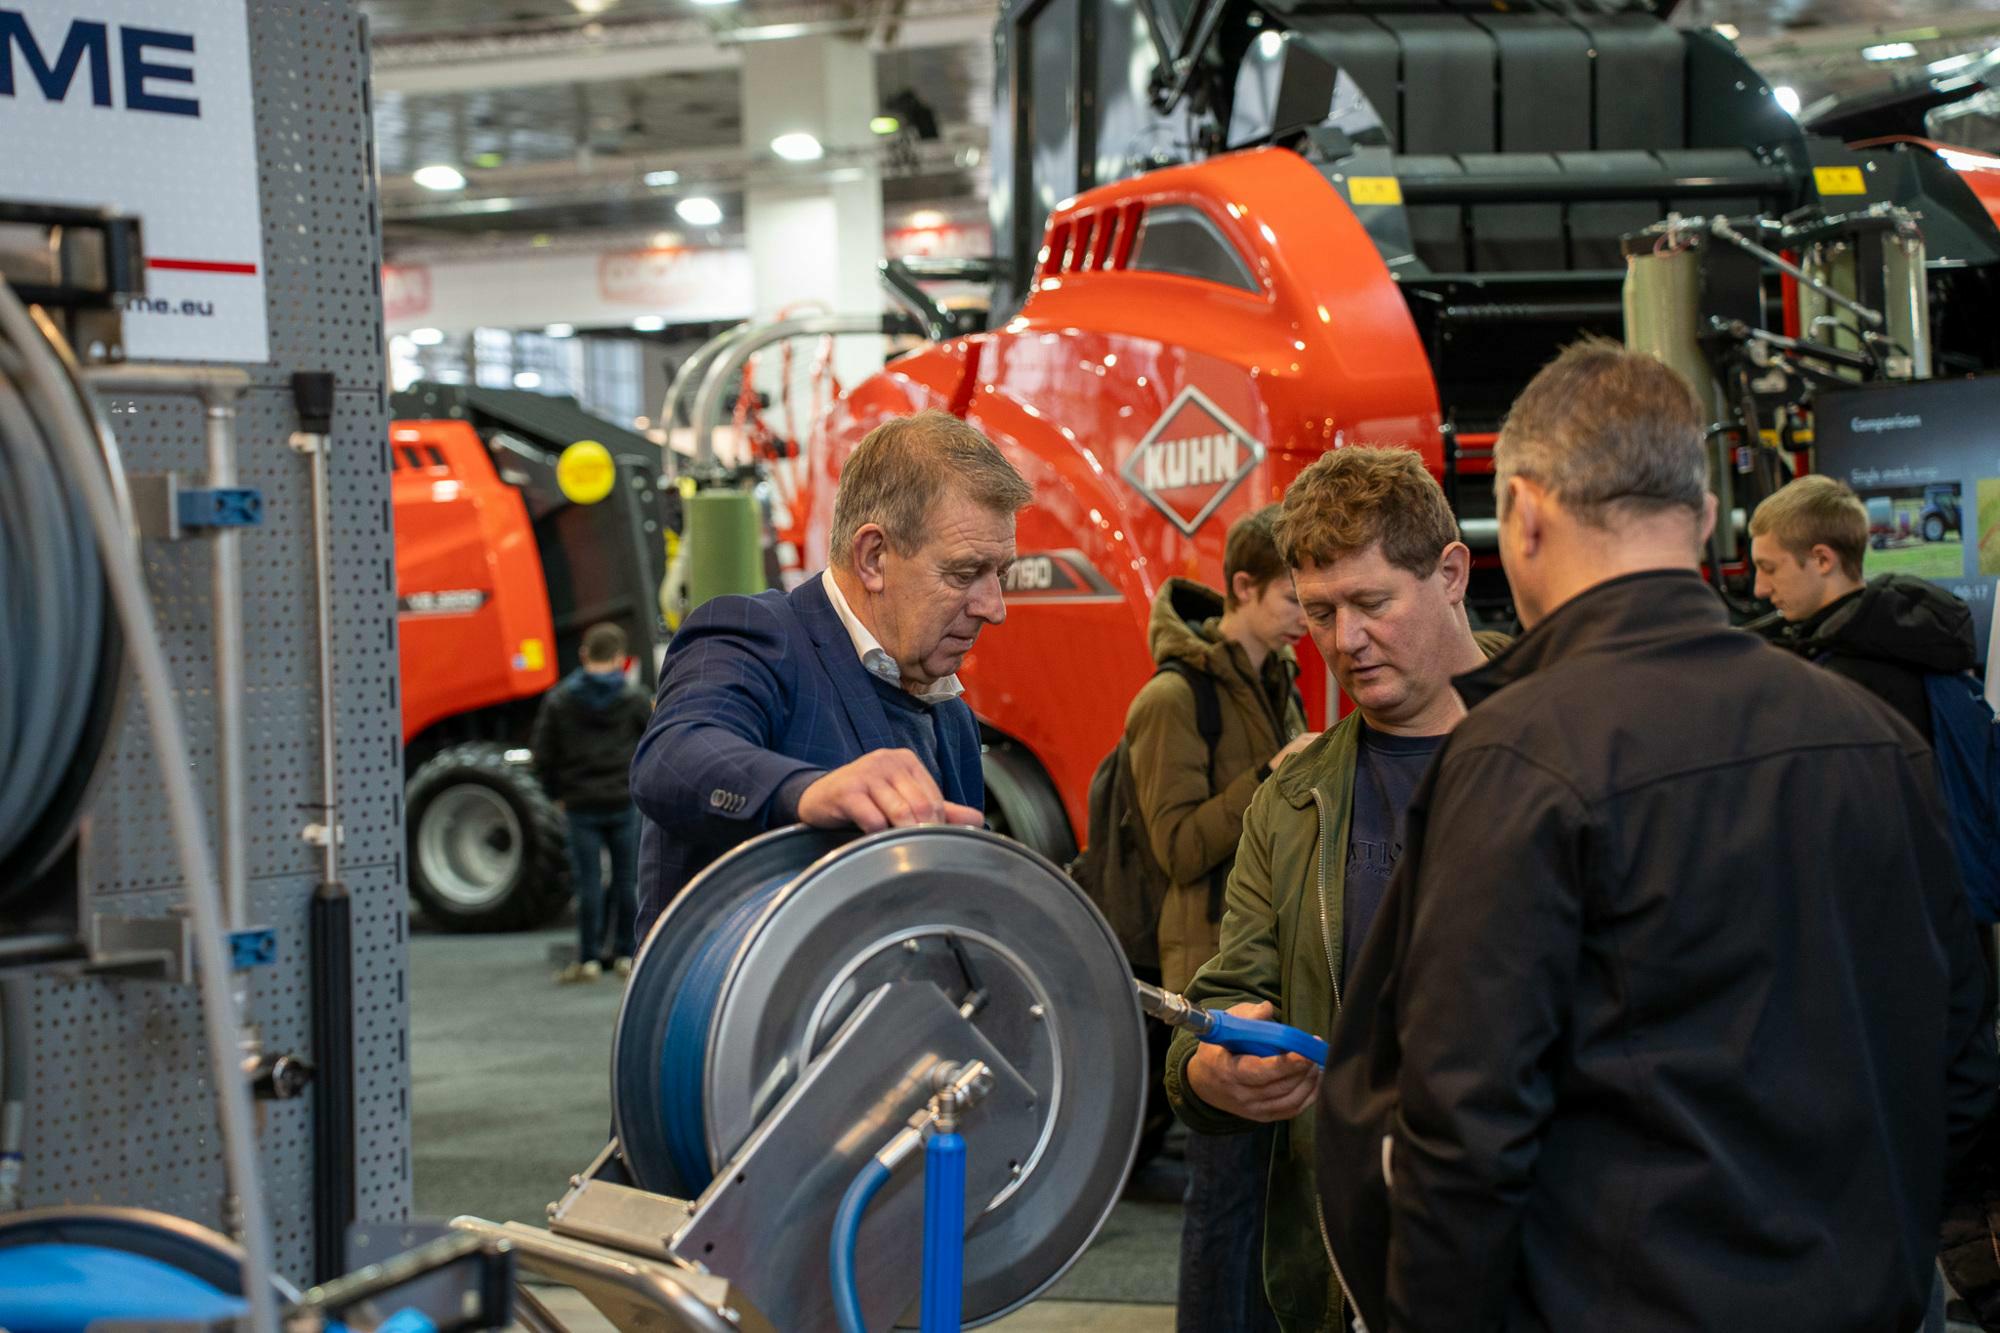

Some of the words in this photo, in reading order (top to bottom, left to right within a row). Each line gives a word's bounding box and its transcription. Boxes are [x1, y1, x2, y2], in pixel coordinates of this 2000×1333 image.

[0, 10, 201, 118] ME
[1851, 413, 1921, 432] Comparison
[1144, 433, 1239, 490] KUHN
